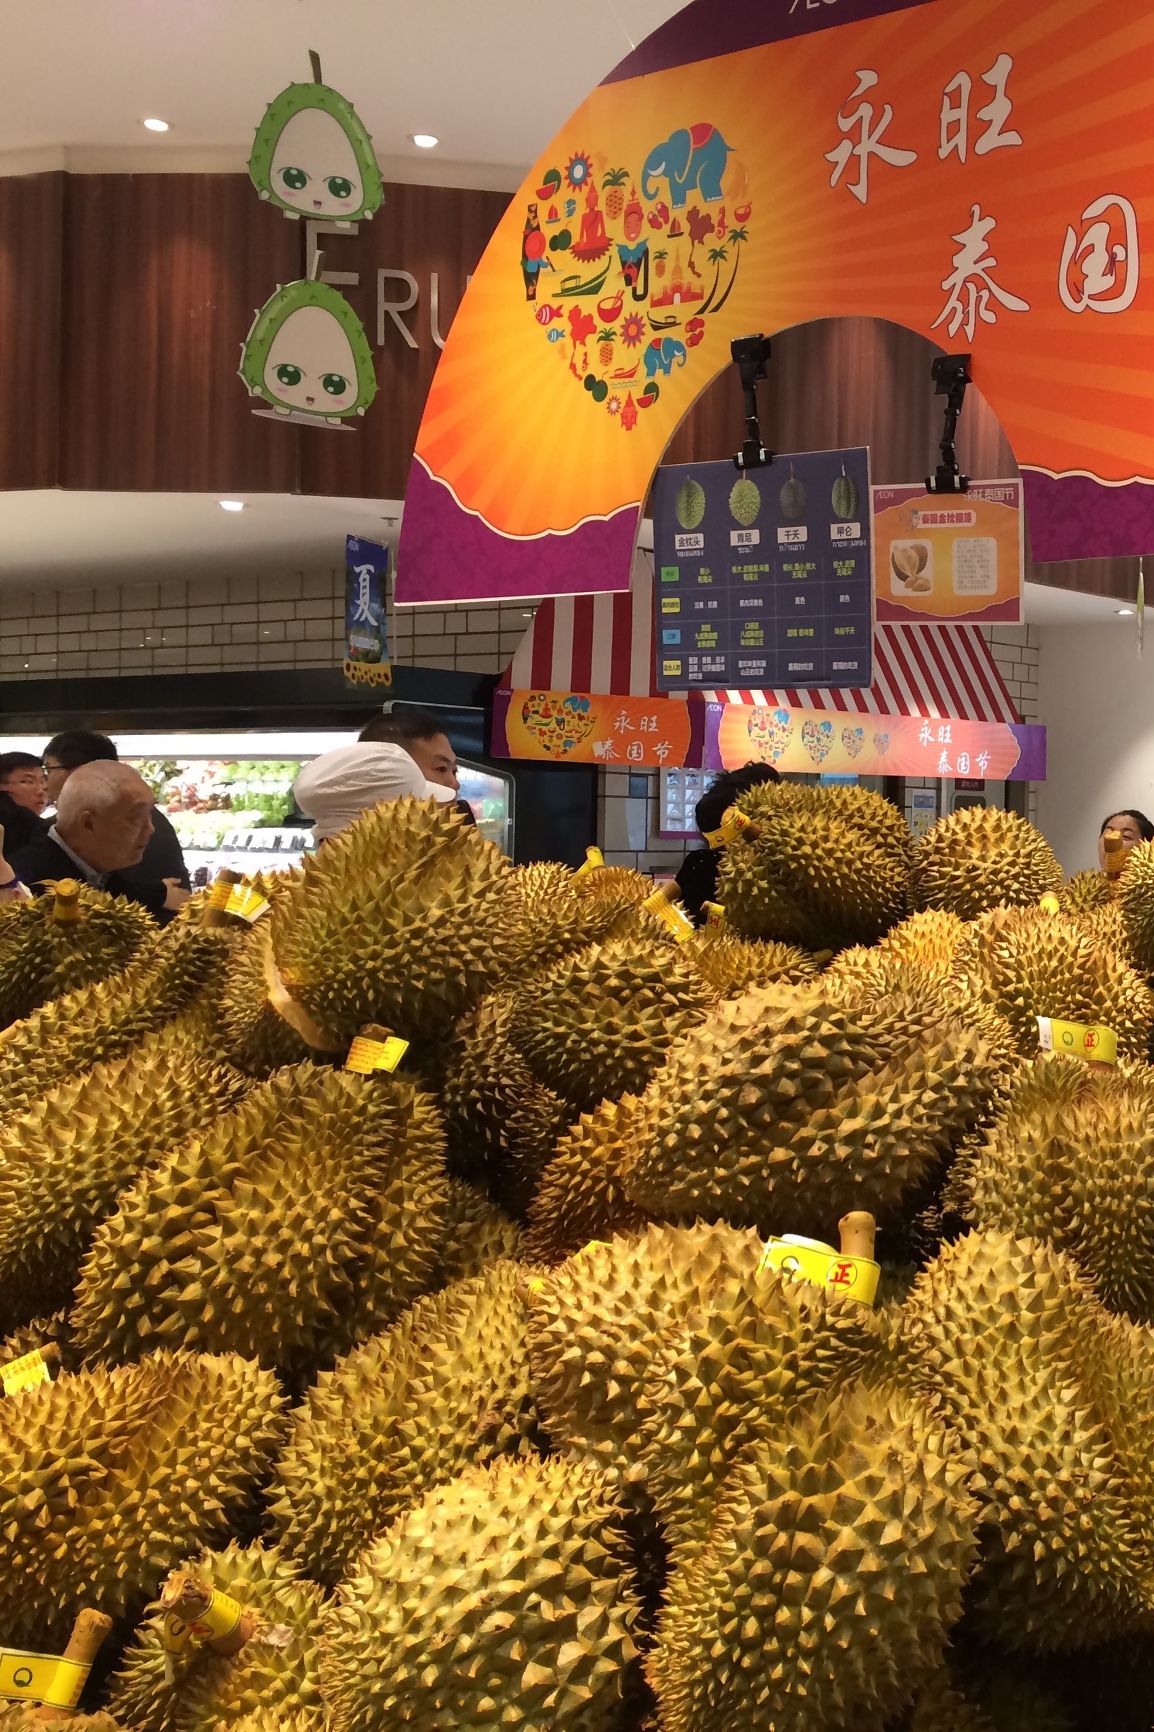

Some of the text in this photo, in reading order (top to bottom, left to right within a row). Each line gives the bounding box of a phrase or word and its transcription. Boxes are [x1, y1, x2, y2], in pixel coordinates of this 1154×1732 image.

[824, 52, 1024, 204] 永旺
[678, 536, 701, 547] 金枕头
[837, 526, 853, 537] 甲仑
[353, 564, 379, 626] 夏
[613, 710, 660, 735] 永旺
[918, 720, 953, 744] 永旺
[597, 741, 673, 764] 泰国节
[936, 751, 992, 776] 泰国节
[829, 1263, 852, 1285] 正
